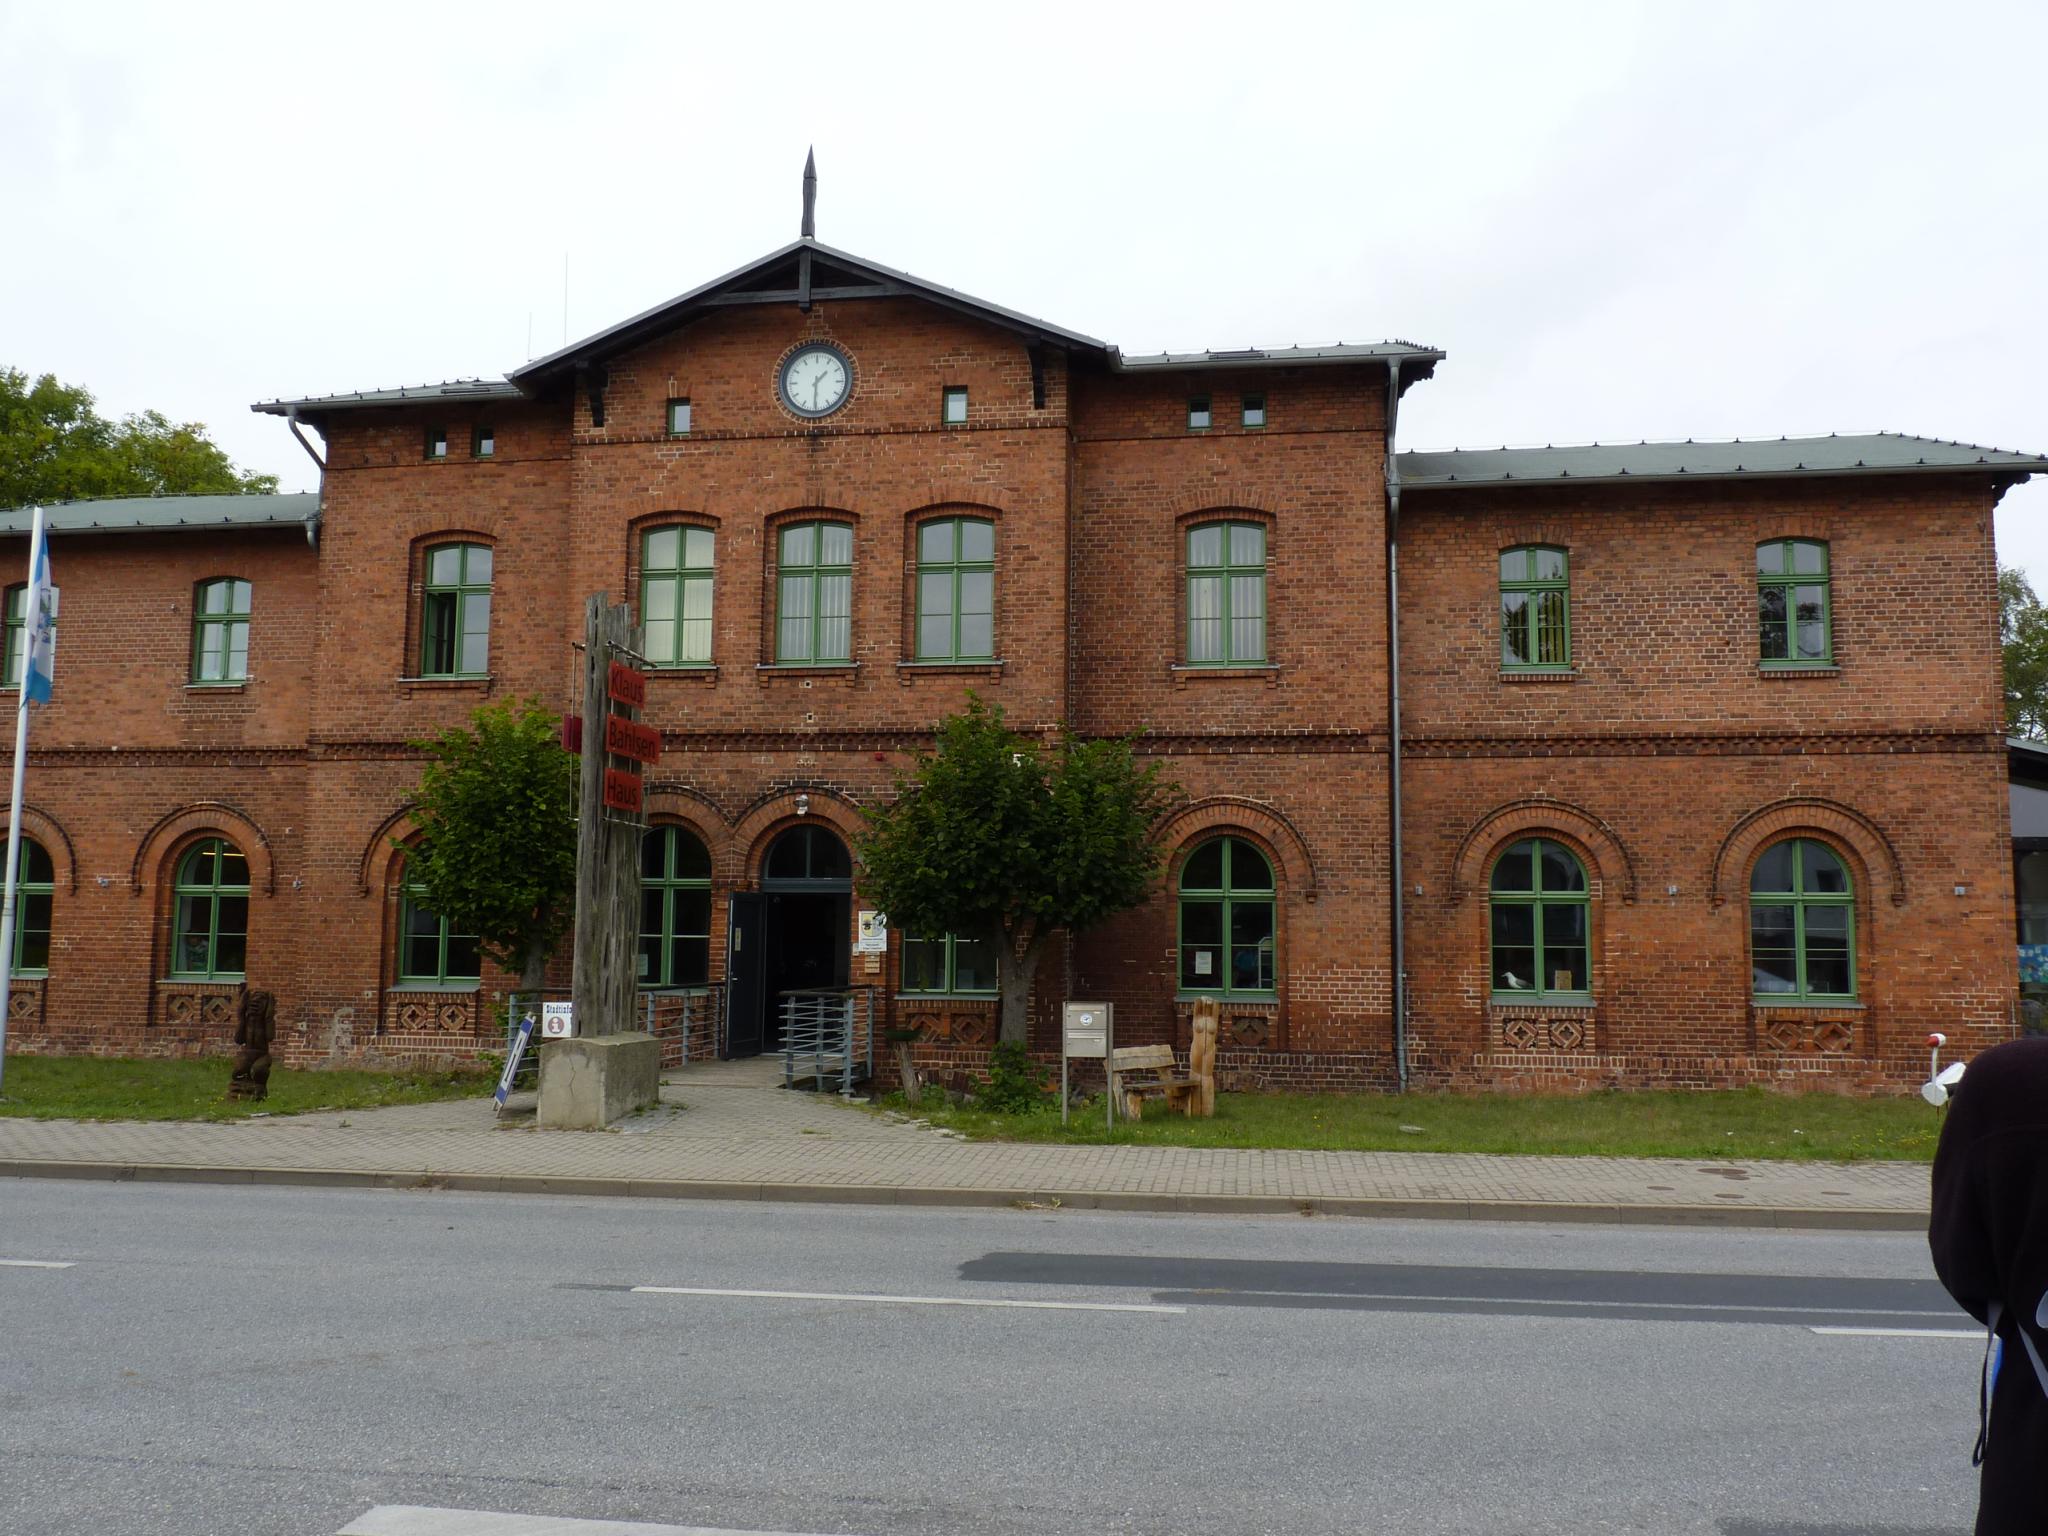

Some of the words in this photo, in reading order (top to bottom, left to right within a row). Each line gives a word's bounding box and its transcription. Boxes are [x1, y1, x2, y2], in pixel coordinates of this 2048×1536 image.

[612, 669, 644, 702] Klaus
[609, 721, 656, 759] Bahlsen
[608, 775, 637, 806] Haus
